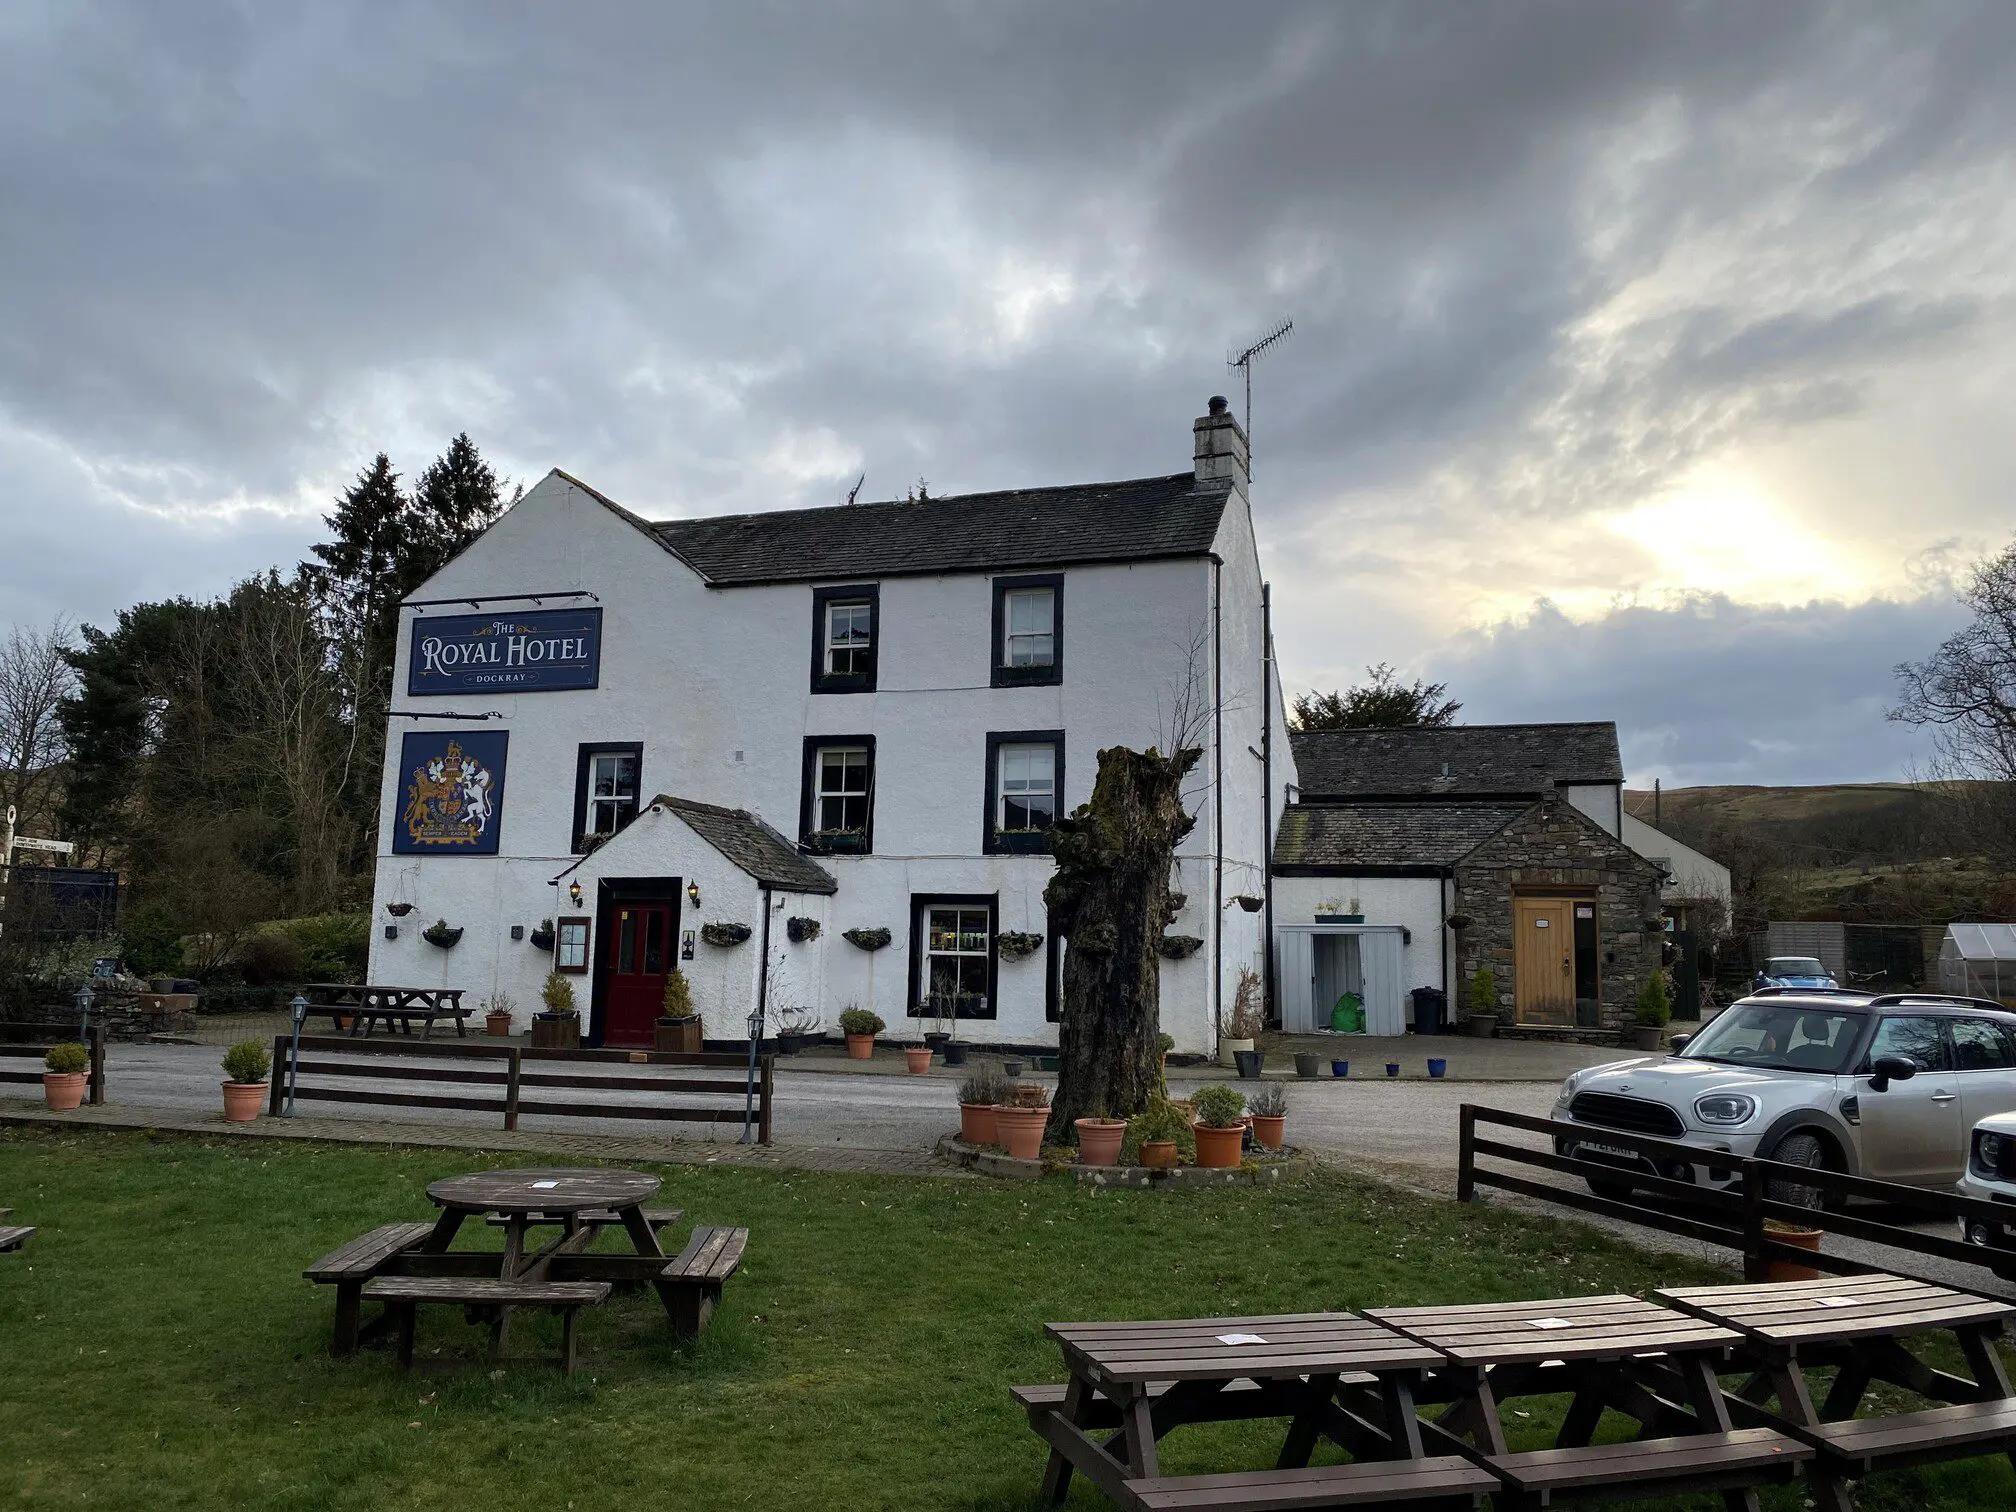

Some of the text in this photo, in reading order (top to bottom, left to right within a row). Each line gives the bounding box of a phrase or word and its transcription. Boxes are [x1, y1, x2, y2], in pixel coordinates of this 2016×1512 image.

[493, 621, 515, 636] THE
[421, 635, 588, 676] ROYAL HOTEL
[476, 673, 526, 683] DOCKRAY
